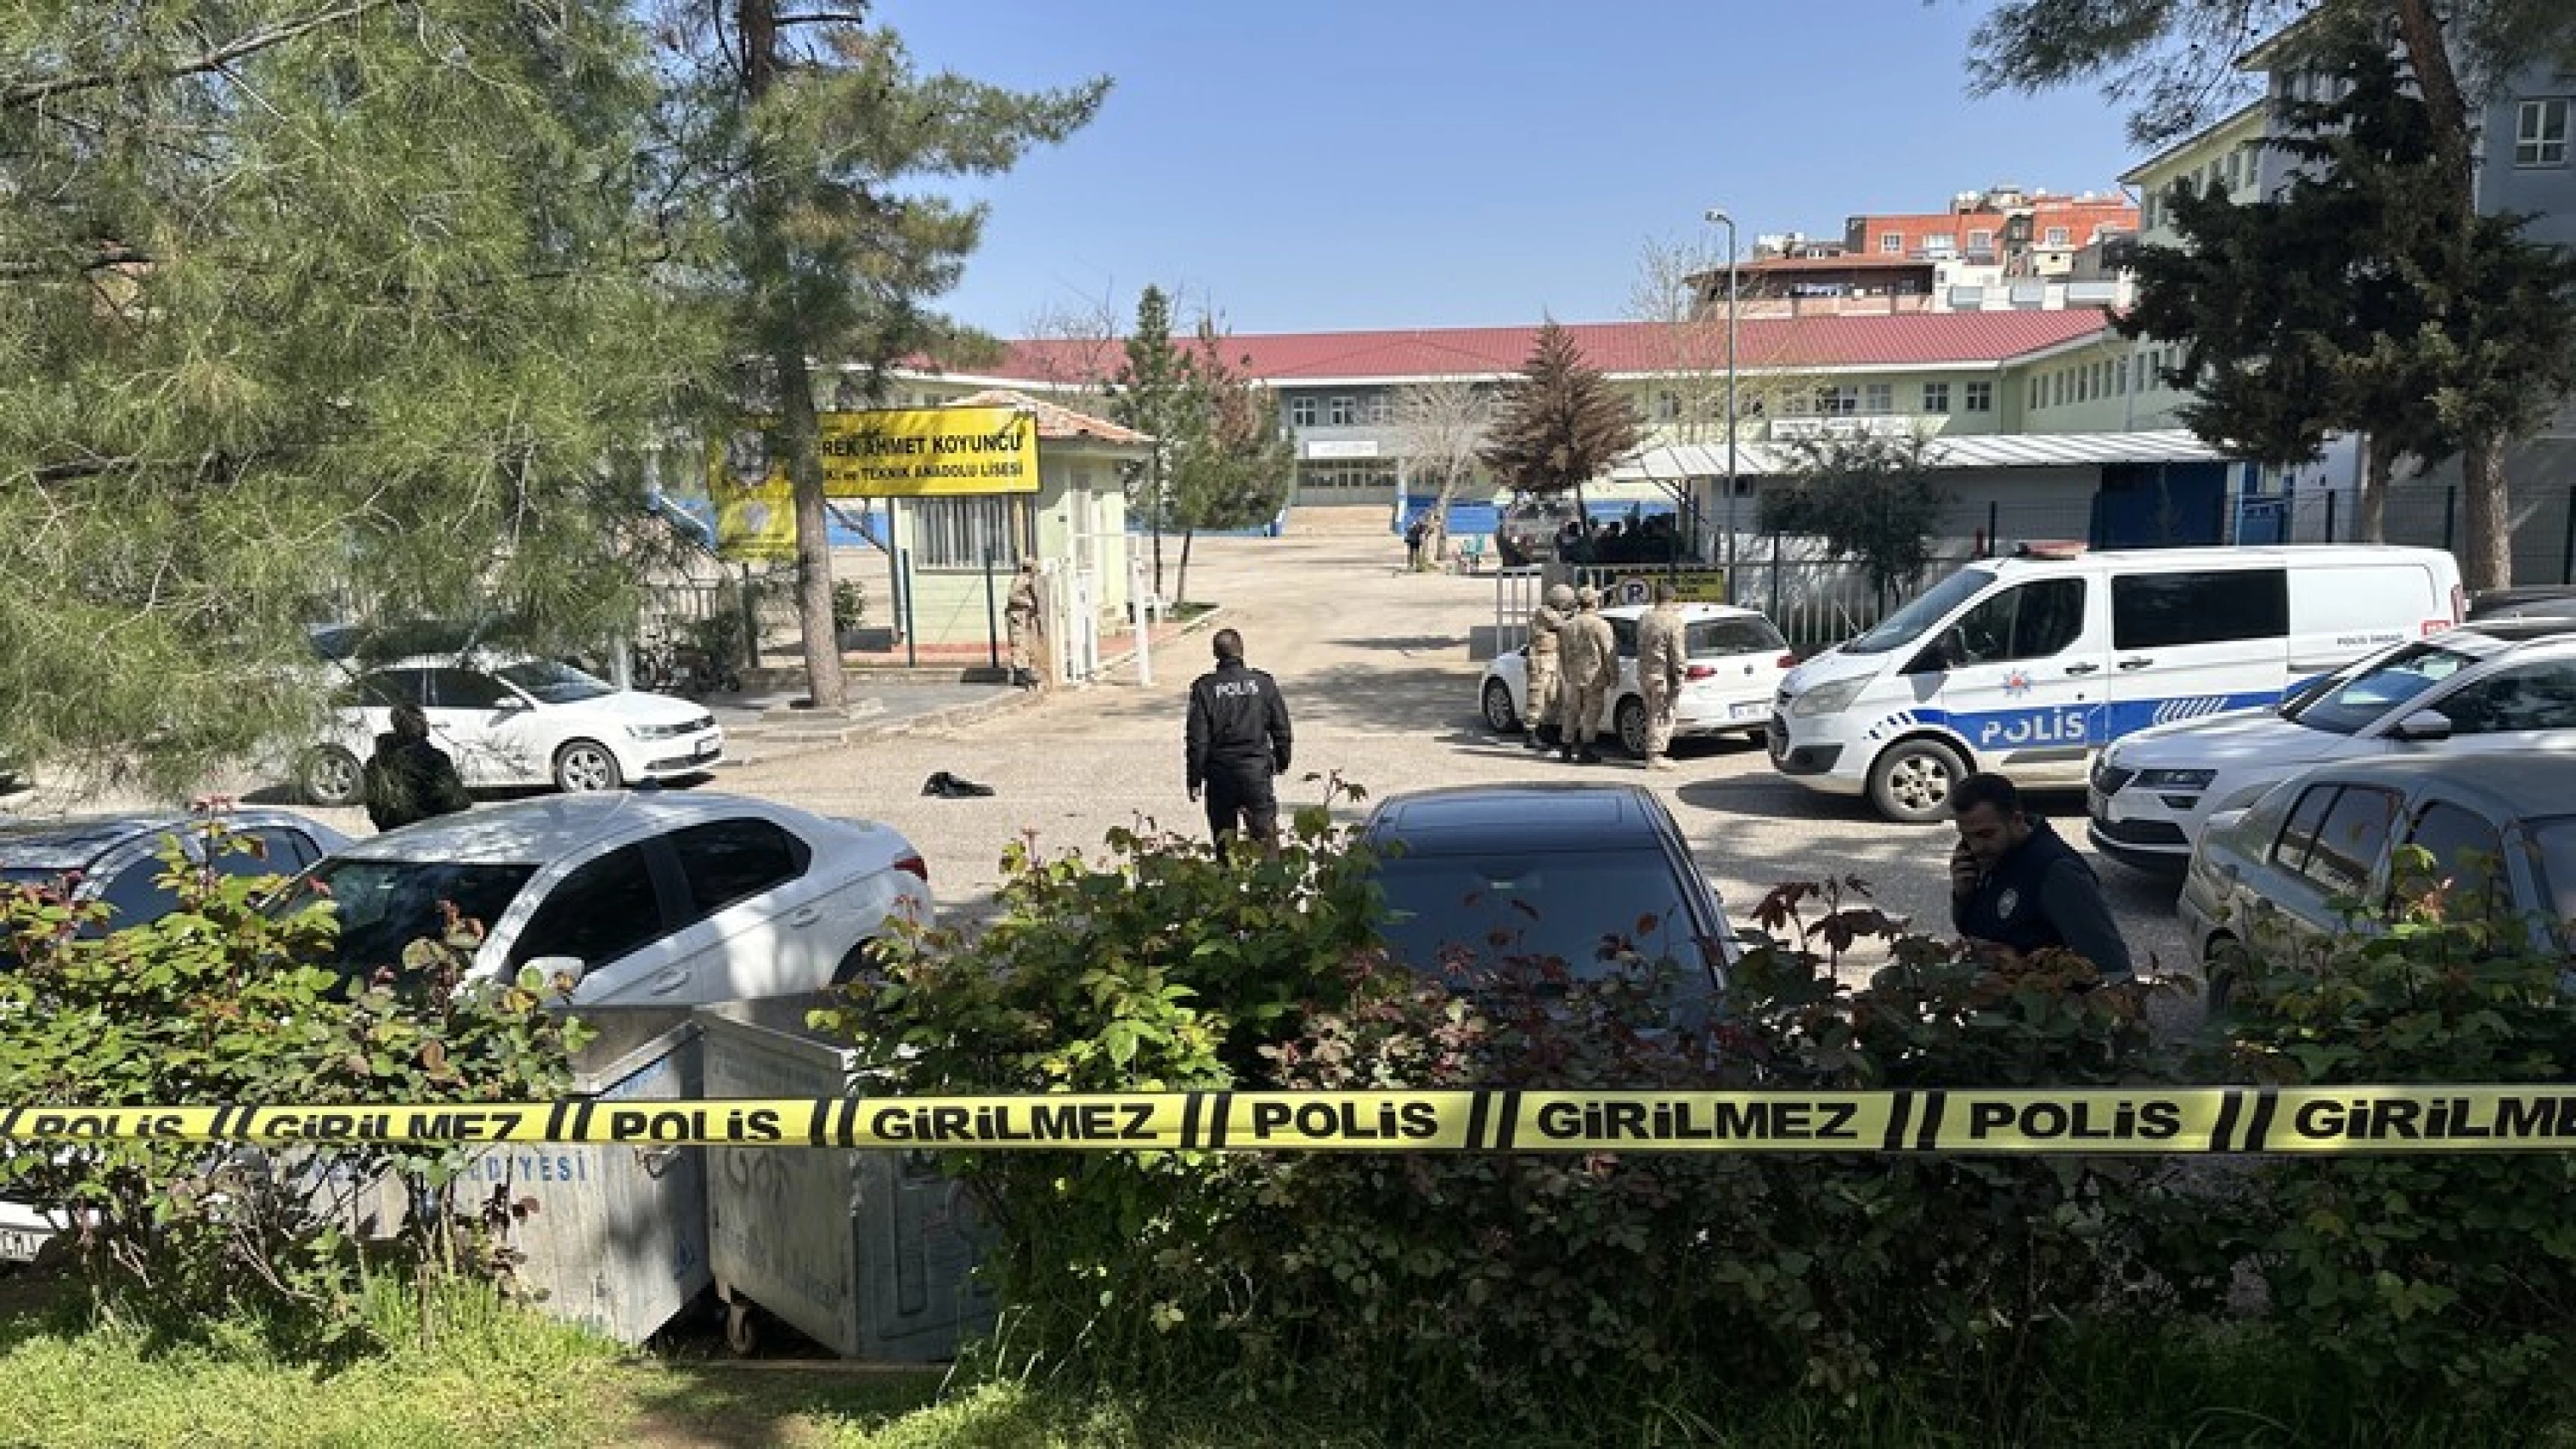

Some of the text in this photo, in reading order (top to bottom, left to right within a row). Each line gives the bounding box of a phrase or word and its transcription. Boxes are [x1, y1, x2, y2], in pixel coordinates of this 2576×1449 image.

[865, 436, 927, 456] AHMET
[933, 433, 1022, 454] KOYUNCU
[914, 464, 977, 478] ANADOLU
